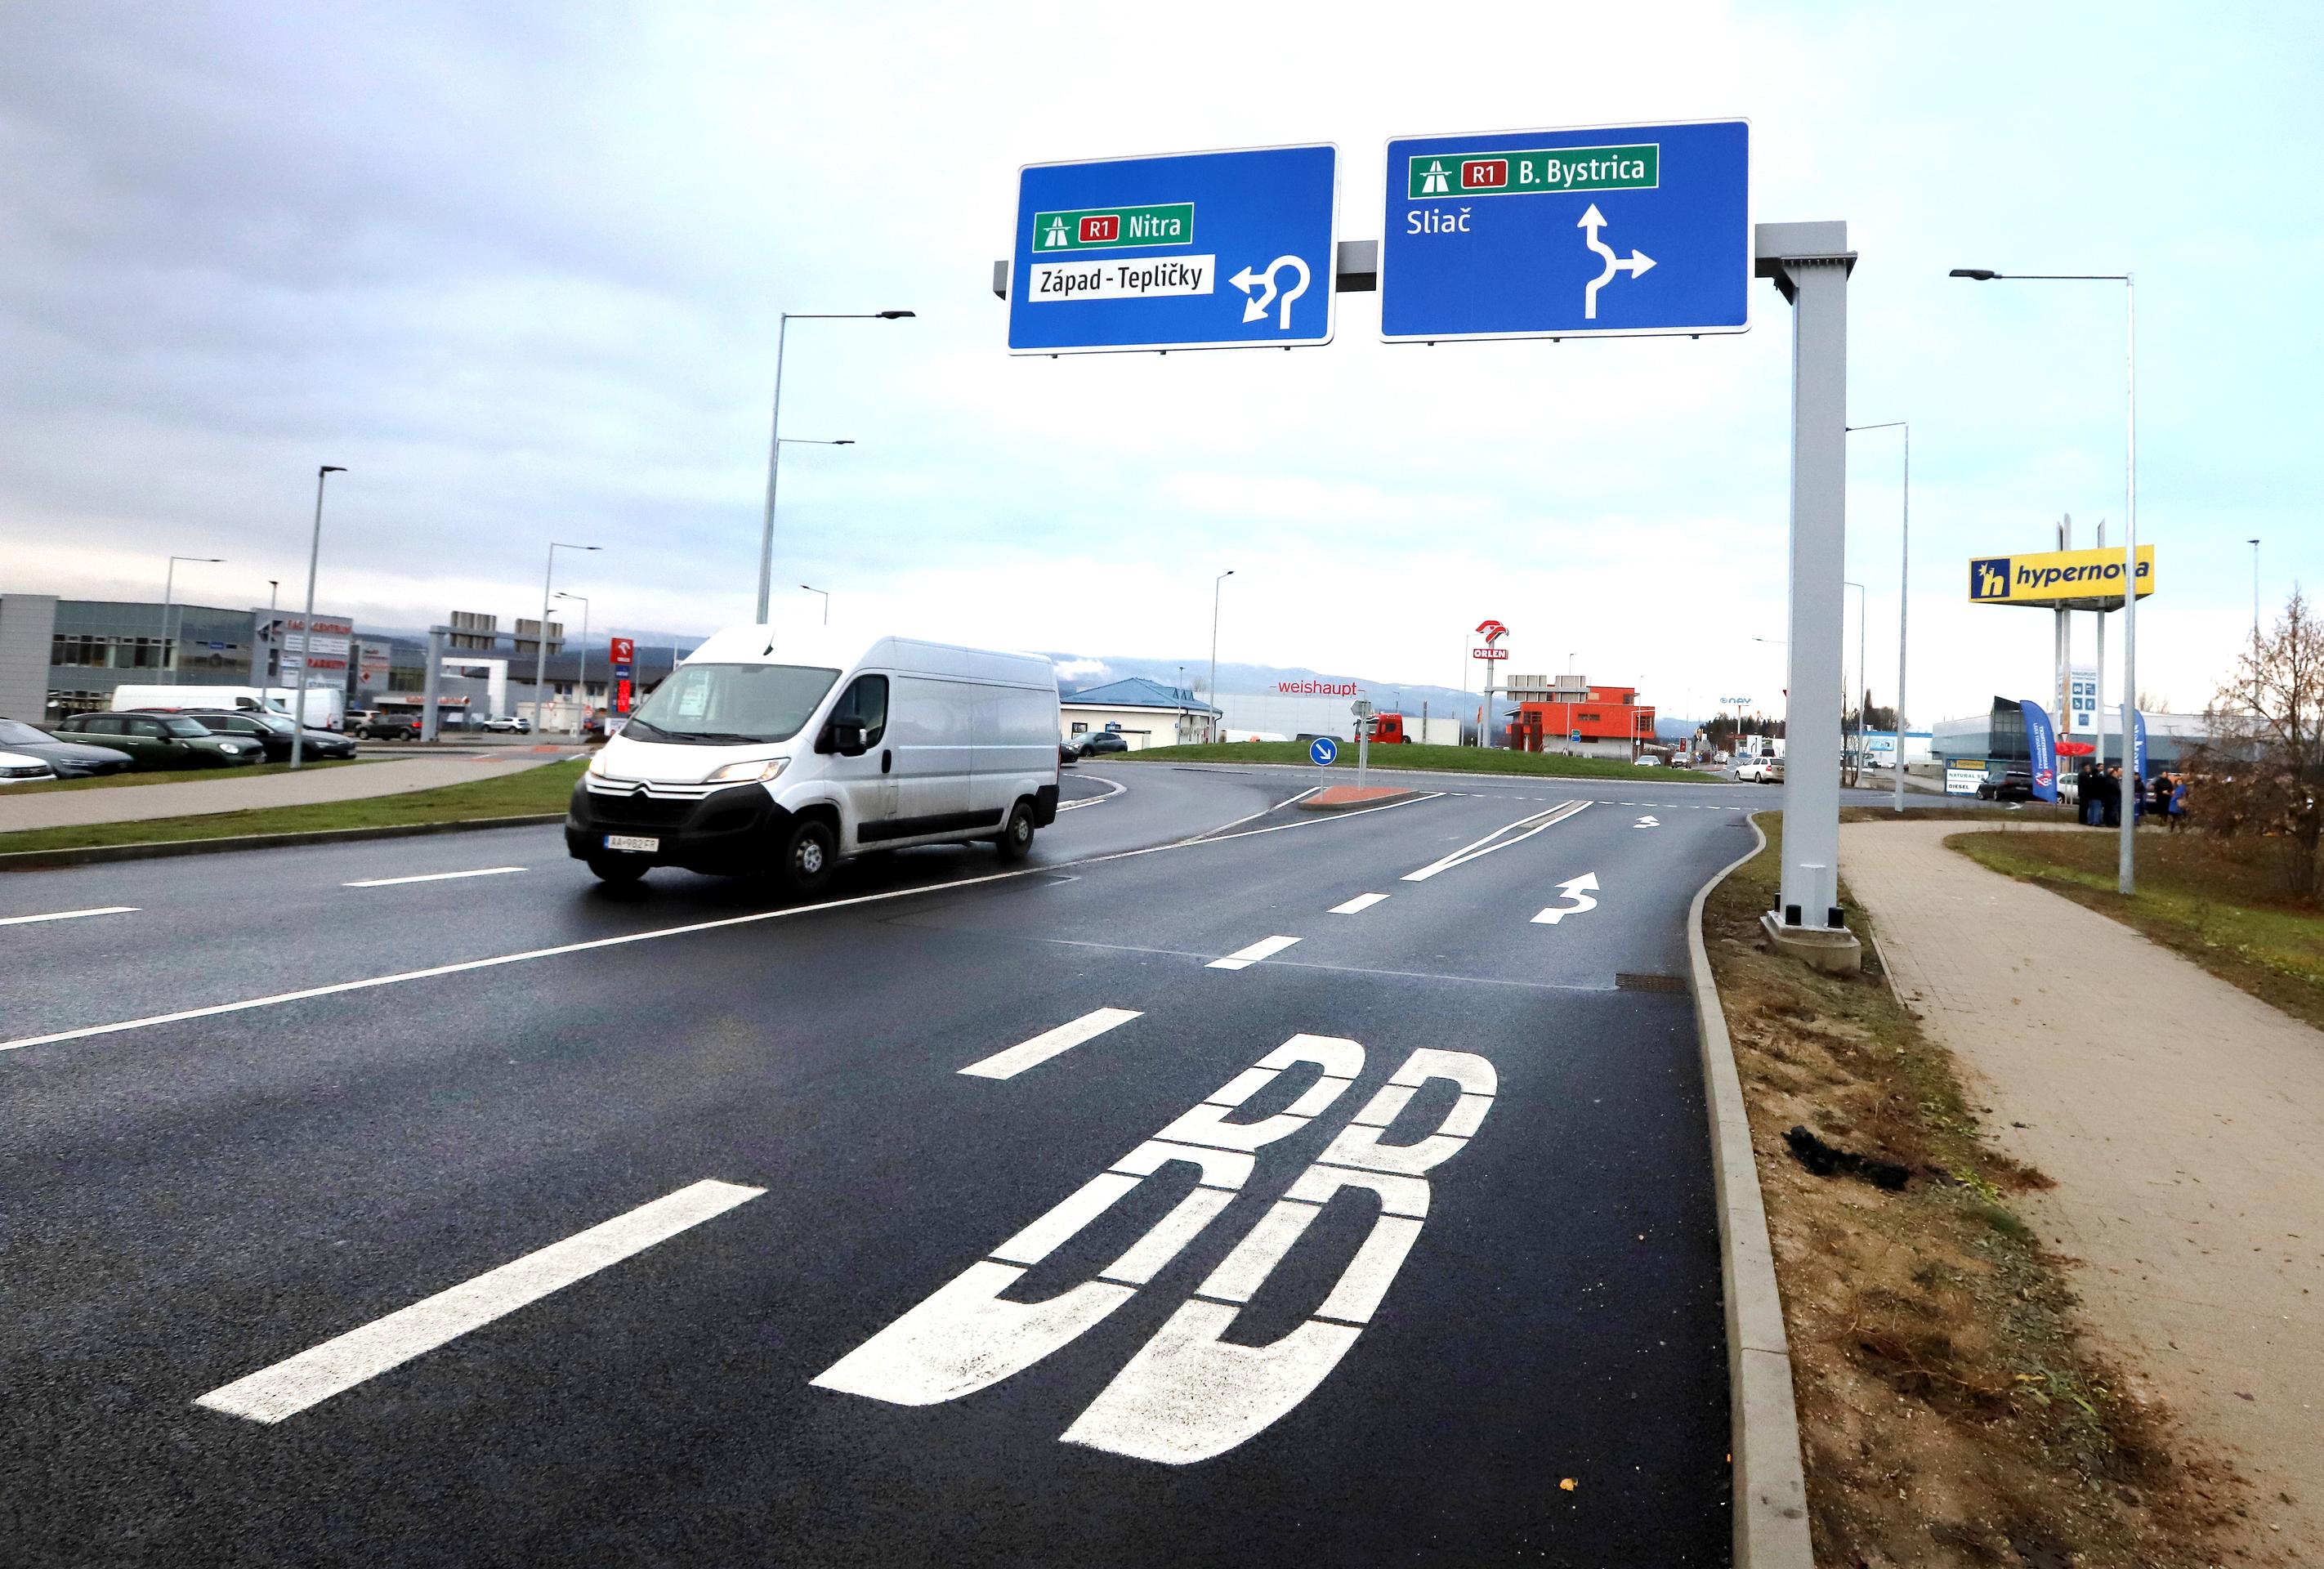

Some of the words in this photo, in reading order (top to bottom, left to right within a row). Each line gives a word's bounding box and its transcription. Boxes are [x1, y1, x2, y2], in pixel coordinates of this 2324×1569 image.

[1473, 165, 1495, 183] R1
[1519, 160, 1541, 184] B.
[1547, 154, 1645, 188] Bystrica
[1089, 221, 1109, 237] R1
[1129, 214, 1181, 238] Nitra
[1406, 208, 1472, 235] Sliač
[1040, 269, 1102, 296] Západ
[1118, 263, 1203, 293] Tepličky
[1473, 650, 1506, 658] ORLEN
[1278, 680, 1357, 696] weishaupt
[809, 1032, 1498, 1464] BB
